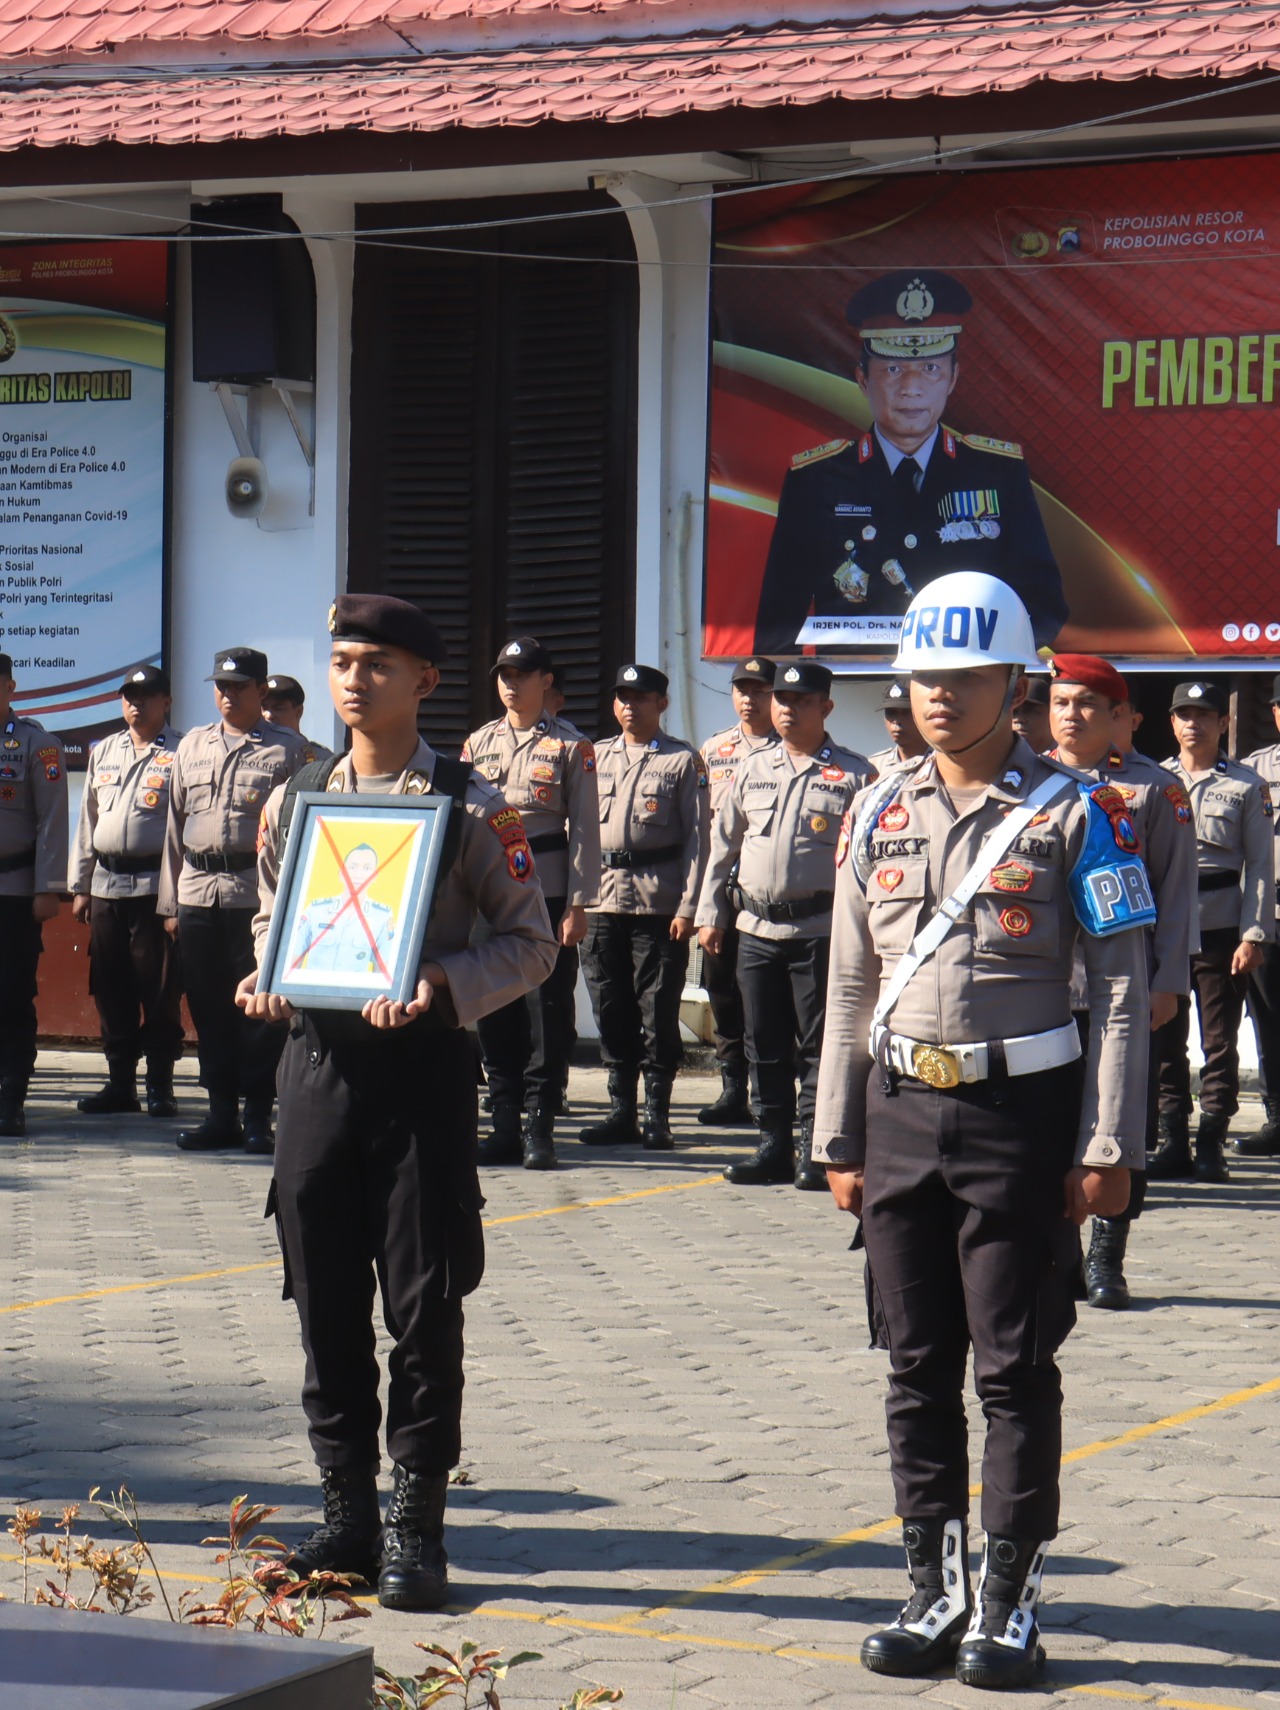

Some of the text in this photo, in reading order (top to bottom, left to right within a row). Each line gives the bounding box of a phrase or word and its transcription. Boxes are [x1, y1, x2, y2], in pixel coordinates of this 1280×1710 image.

[1104, 211, 1243, 231] KEPOLISIAN RESOR
[1103, 229, 1265, 249] PROBOLINGGO KOTA
[32, 258, 112, 270] ZONA INTEGRITAS
[54, 370, 132, 403] KAPOLRI
[2, 431, 47, 445] Organisai
[20, 448, 28, 458] di
[32, 447, 47, 458] Era
[51, 447, 79, 457] Police
[82, 446, 95, 456] 4.0
[11, 464, 45, 474] Modern
[49, 463, 57, 473] di
[60, 463, 76, 473] Era
[79, 462, 108, 472] Police
[111, 461, 125, 471] 4.0
[20, 480, 72, 490] Kamtibmas
[8, 496, 40, 506] Hukum
[23, 512, 81, 524] Penanganan
[85, 510, 127, 521] Covid-19
[0, 545, 38, 555] Prioritas
[42, 544, 82, 554] Nasional
[5, 561, 33, 571] Sosial
[8, 577, 37, 587] Publik
[40, 577, 61, 587] Polri
[0, 593, 21, 603] Polri
[24, 595, 47, 605] yang
[50, 592, 112, 605] Terintegritasi
[8, 625, 36, 637] setiap
[39, 625, 79, 638] kegiatan
[813, 622, 887, 630] IRJEN POL. Drs.
[901, 606, 998, 654] PROV
[34, 657, 75, 668] Keadilan
[188, 759, 213, 769] FARIS
[531, 754, 563, 764] POLRI
[643, 771, 678, 780] POLRI
[811, 783, 845, 795] POLRI
[1206, 792, 1242, 807] POLRI
[870, 838, 926, 861] RICKY
